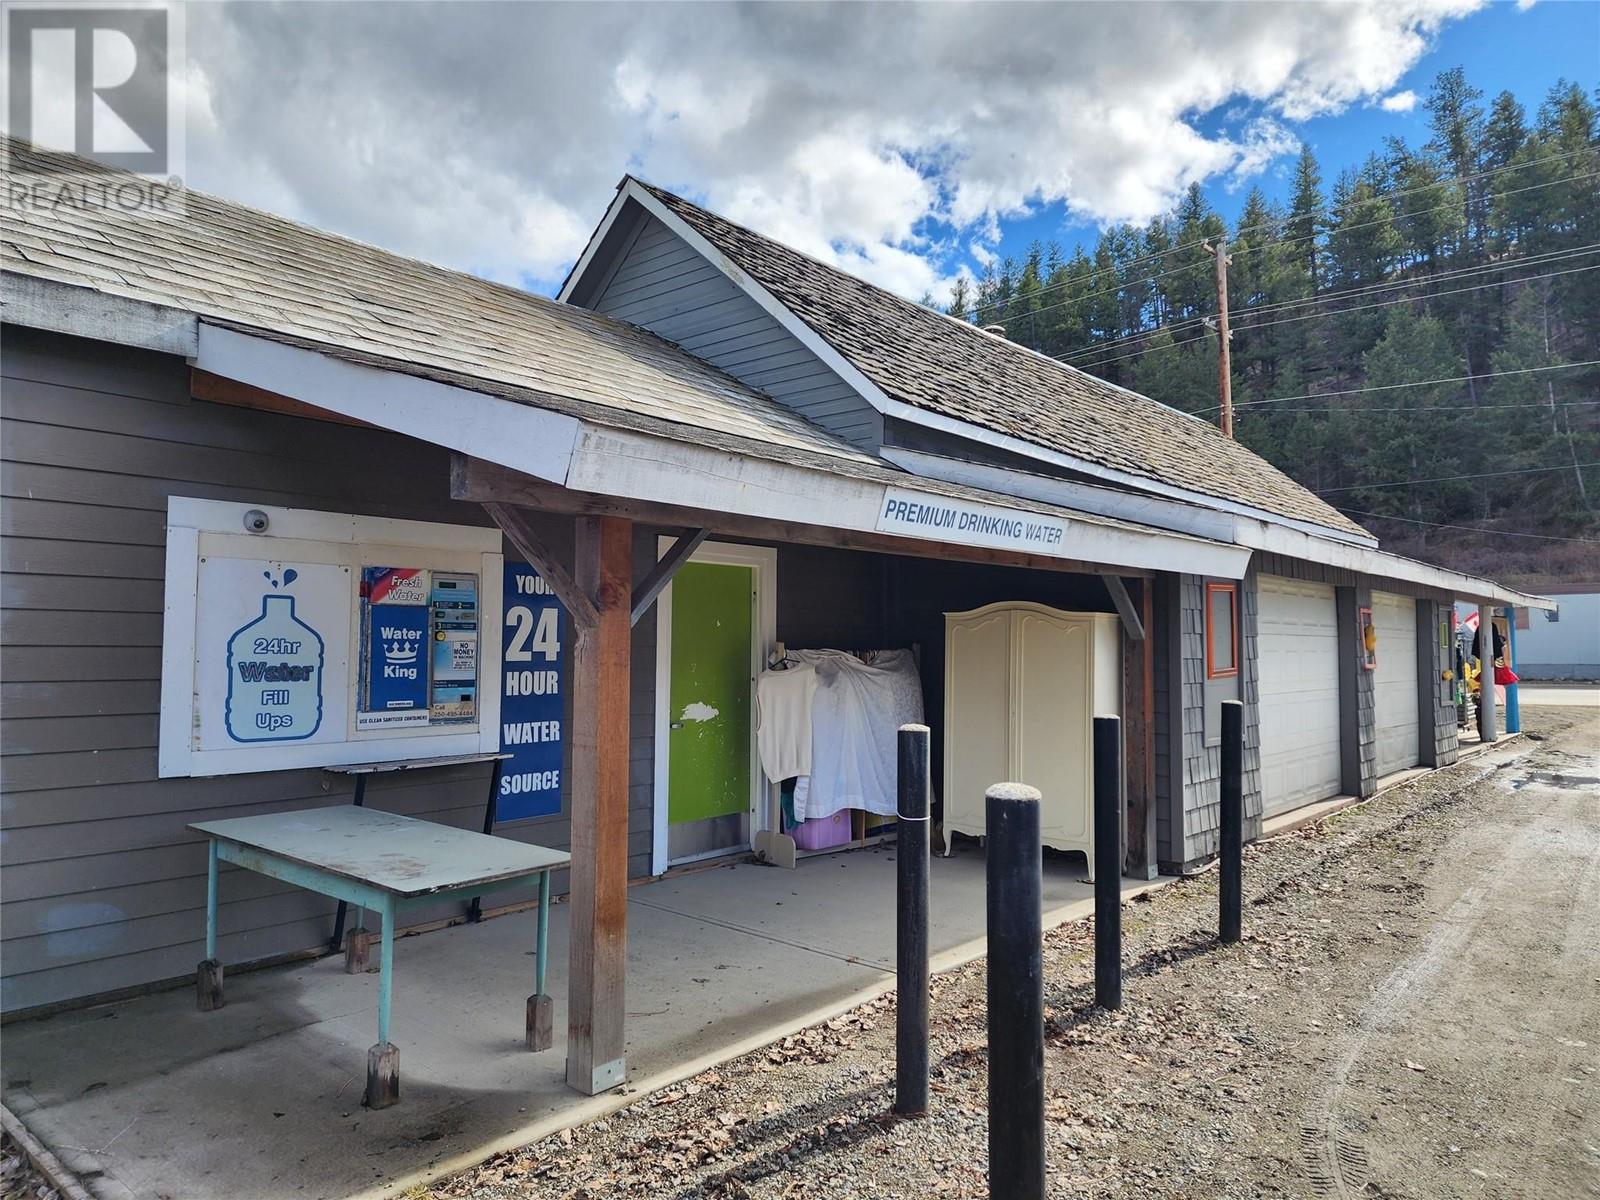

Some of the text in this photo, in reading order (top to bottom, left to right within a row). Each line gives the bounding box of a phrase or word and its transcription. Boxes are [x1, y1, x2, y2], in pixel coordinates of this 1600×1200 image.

[885, 499, 1063, 545] PREMIUM DRINKING WATER
[391, 575, 423, 588] Fresh
[388, 589, 425, 601] Water
[380, 626, 422, 640] Water
[505, 605, 560, 662] 24
[254, 637, 302, 655] 24hr
[238, 661, 315, 683] Water
[383, 665, 418, 680] King
[505, 670, 559, 696] HOUR
[261, 689, 290, 706] Fill
[255, 712, 293, 732] Ups
[503, 720, 560, 745] WATER
[500, 770, 560, 796] SOURCE
